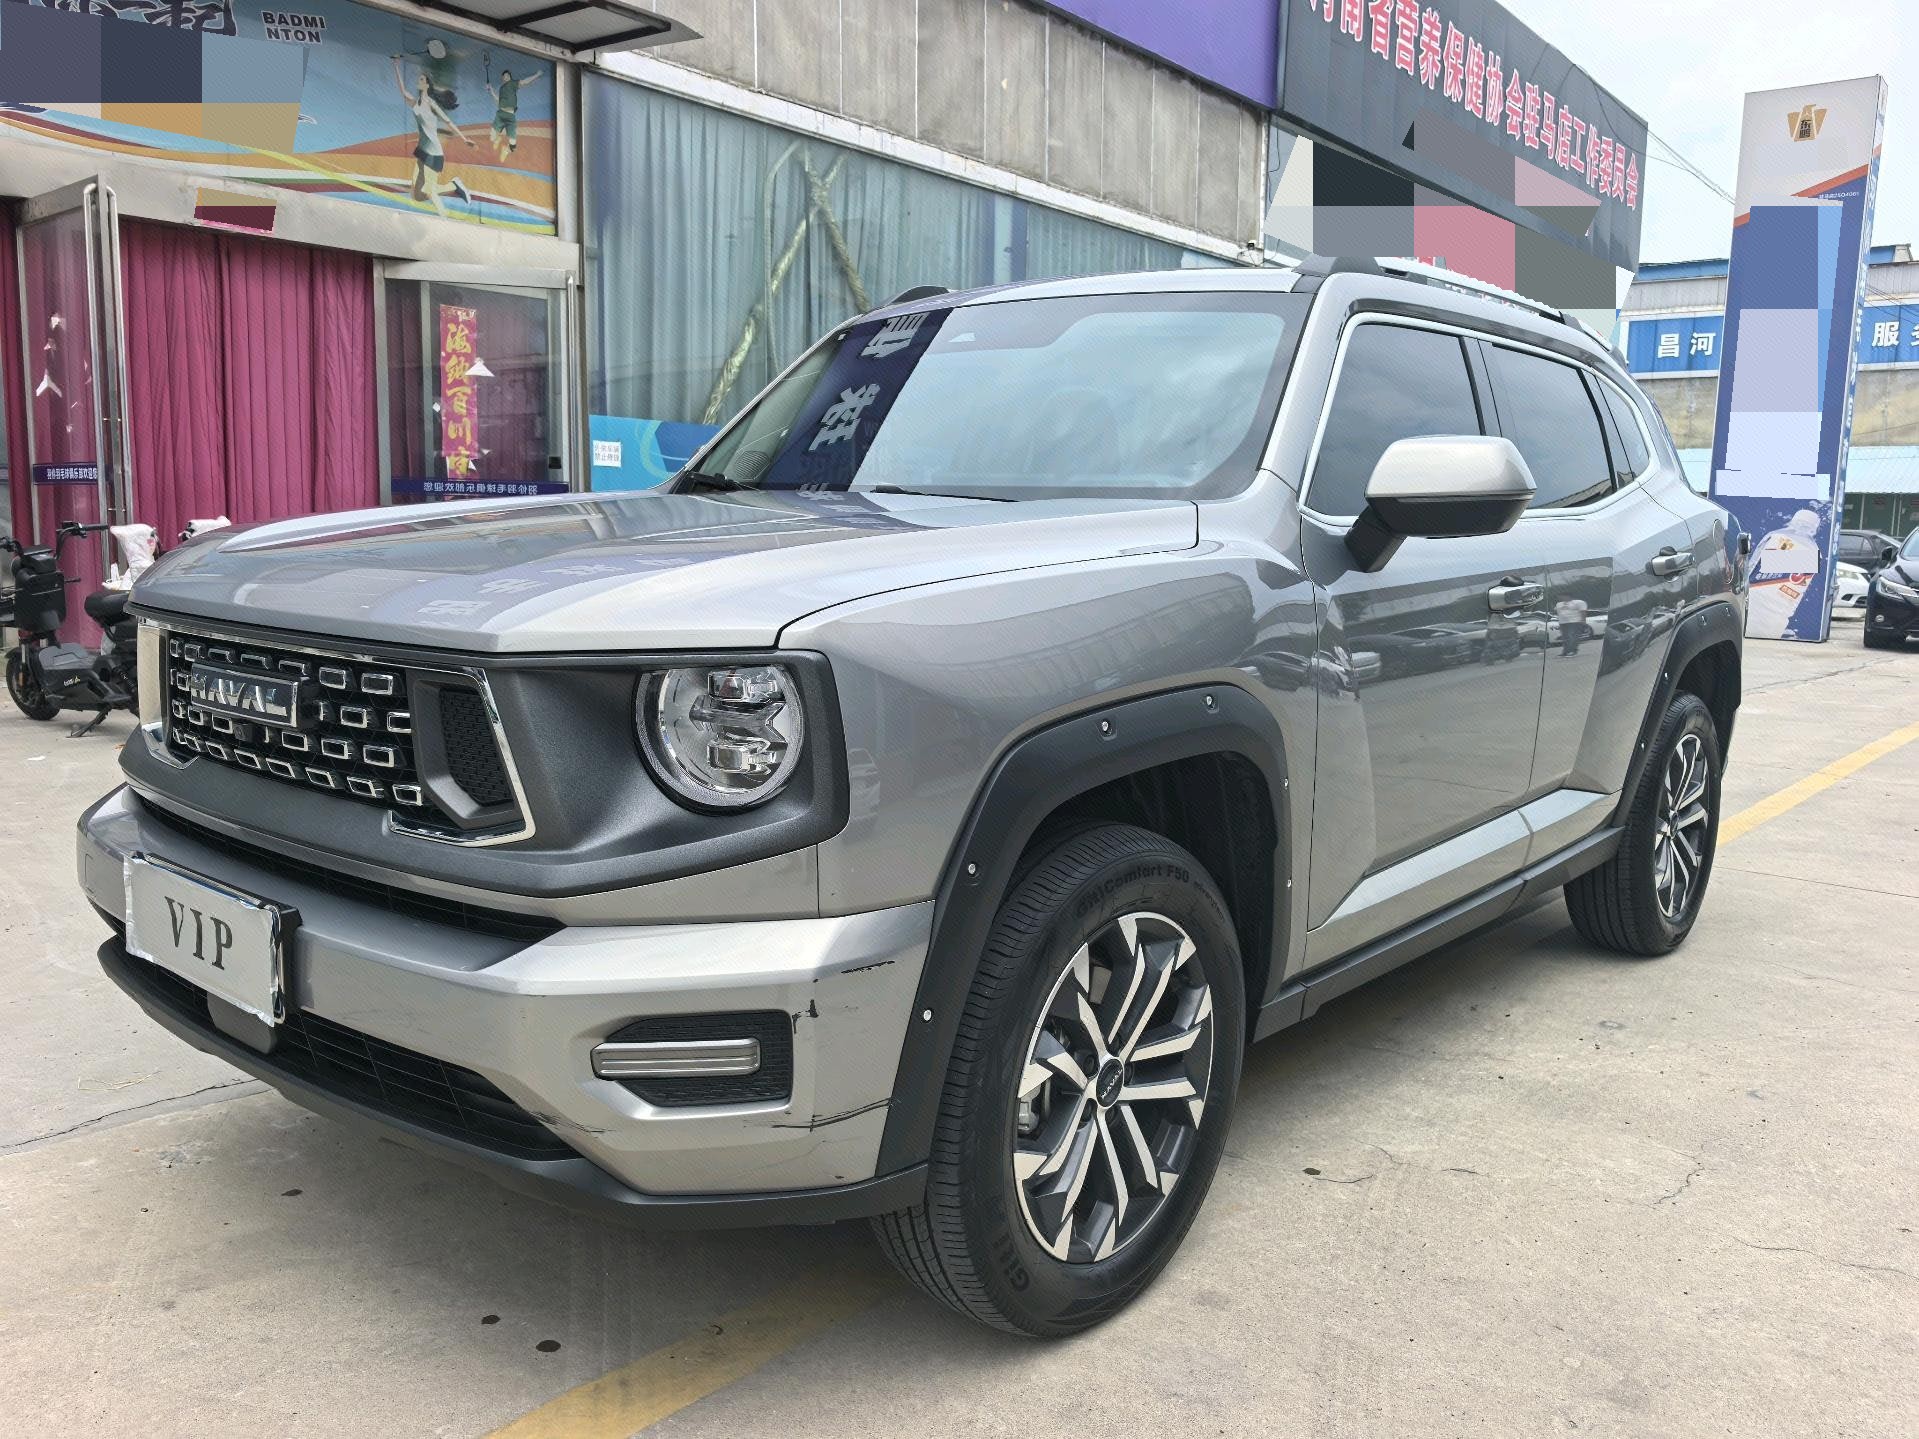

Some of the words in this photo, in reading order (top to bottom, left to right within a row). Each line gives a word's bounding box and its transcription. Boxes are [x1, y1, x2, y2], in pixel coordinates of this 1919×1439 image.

[262, 11, 326, 29] BADMI
[266, 27, 321, 43] NTON
[1309, 0, 1639, 211] 省营养保健协会驻马店工作委员会
[1658, 332, 1717, 359] 昌河
[164, 896, 233, 971] VIP
